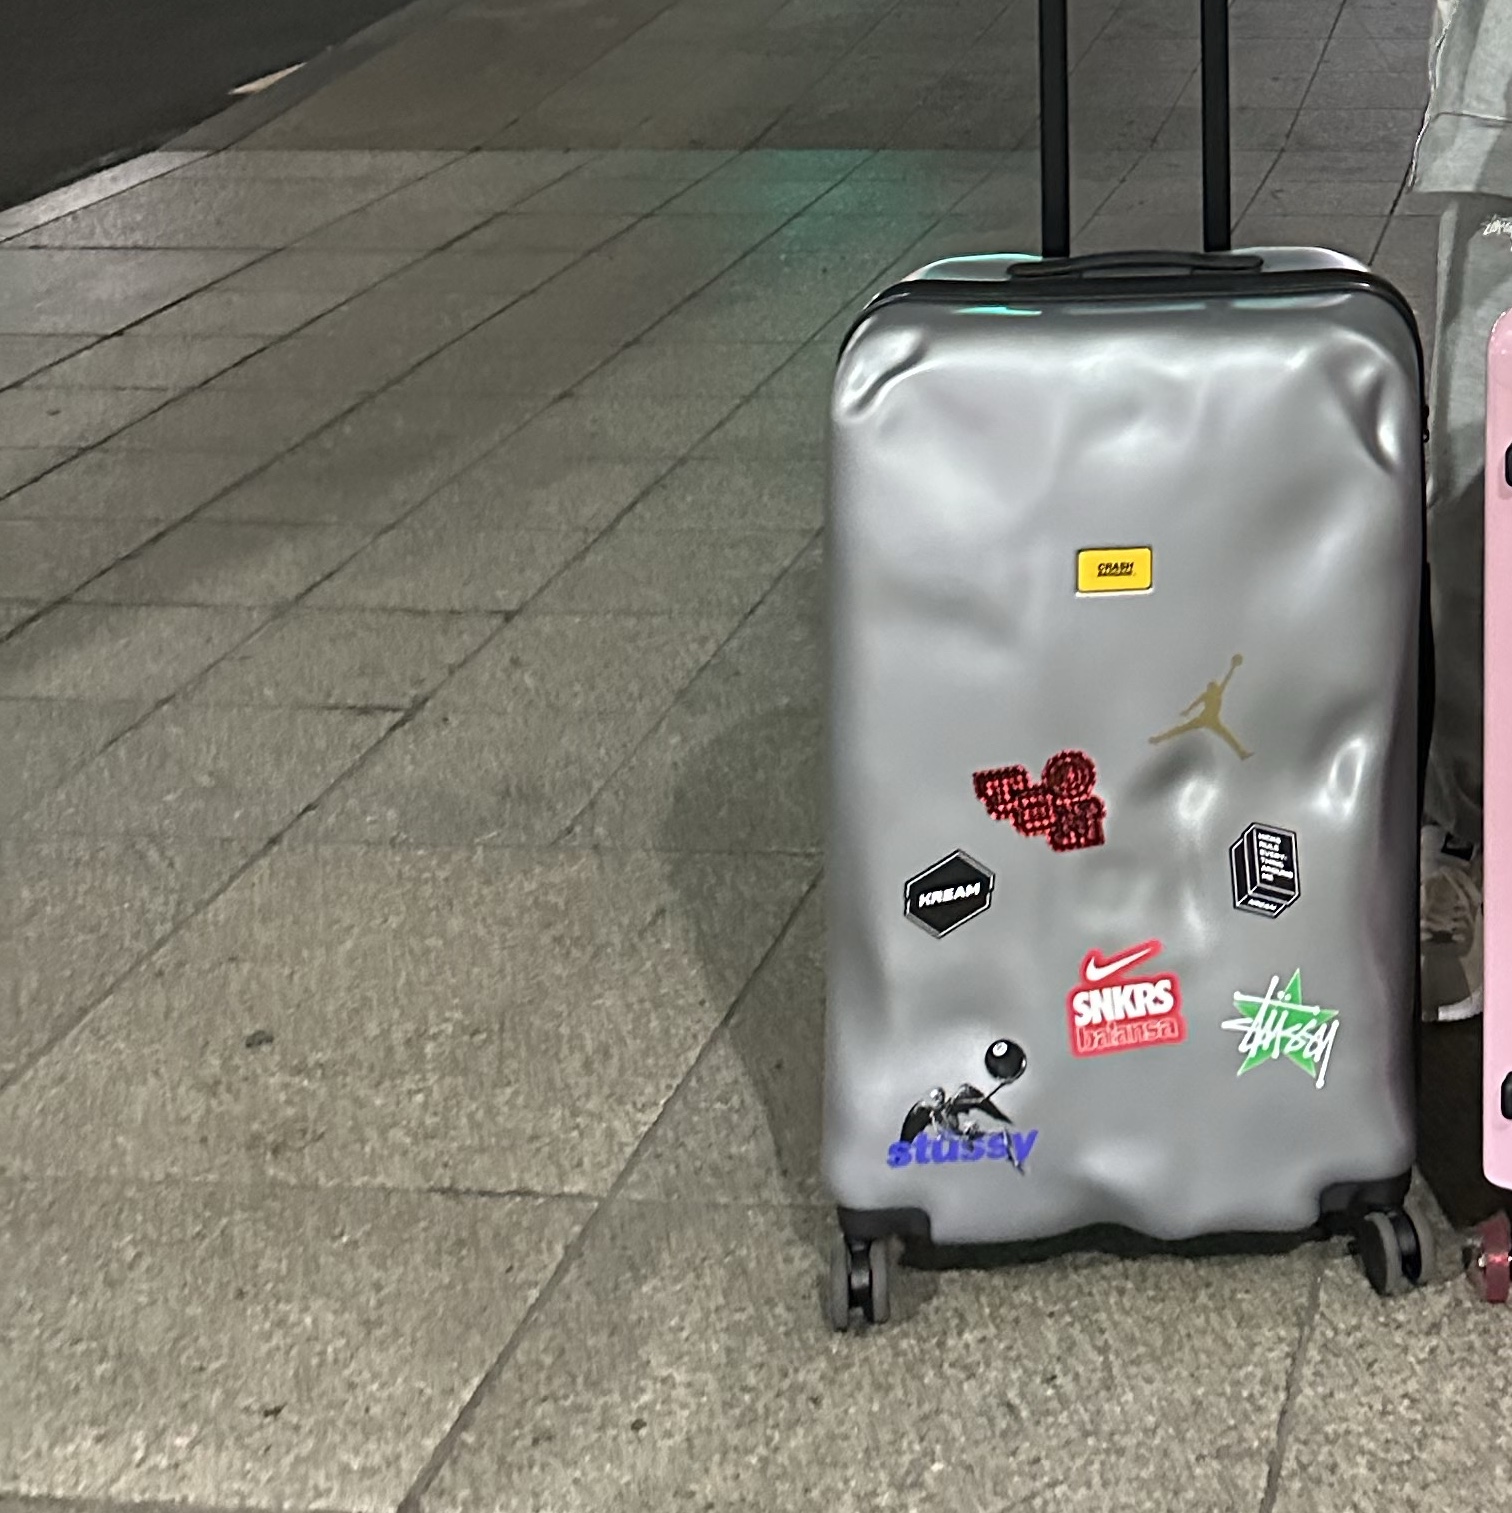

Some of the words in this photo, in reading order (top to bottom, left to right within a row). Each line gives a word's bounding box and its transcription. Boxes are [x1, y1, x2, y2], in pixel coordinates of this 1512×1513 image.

[1098, 561, 1134, 572] CRASH
[919, 882, 981, 908] KREAM
[1072, 979, 1175, 1027] SNKRS
